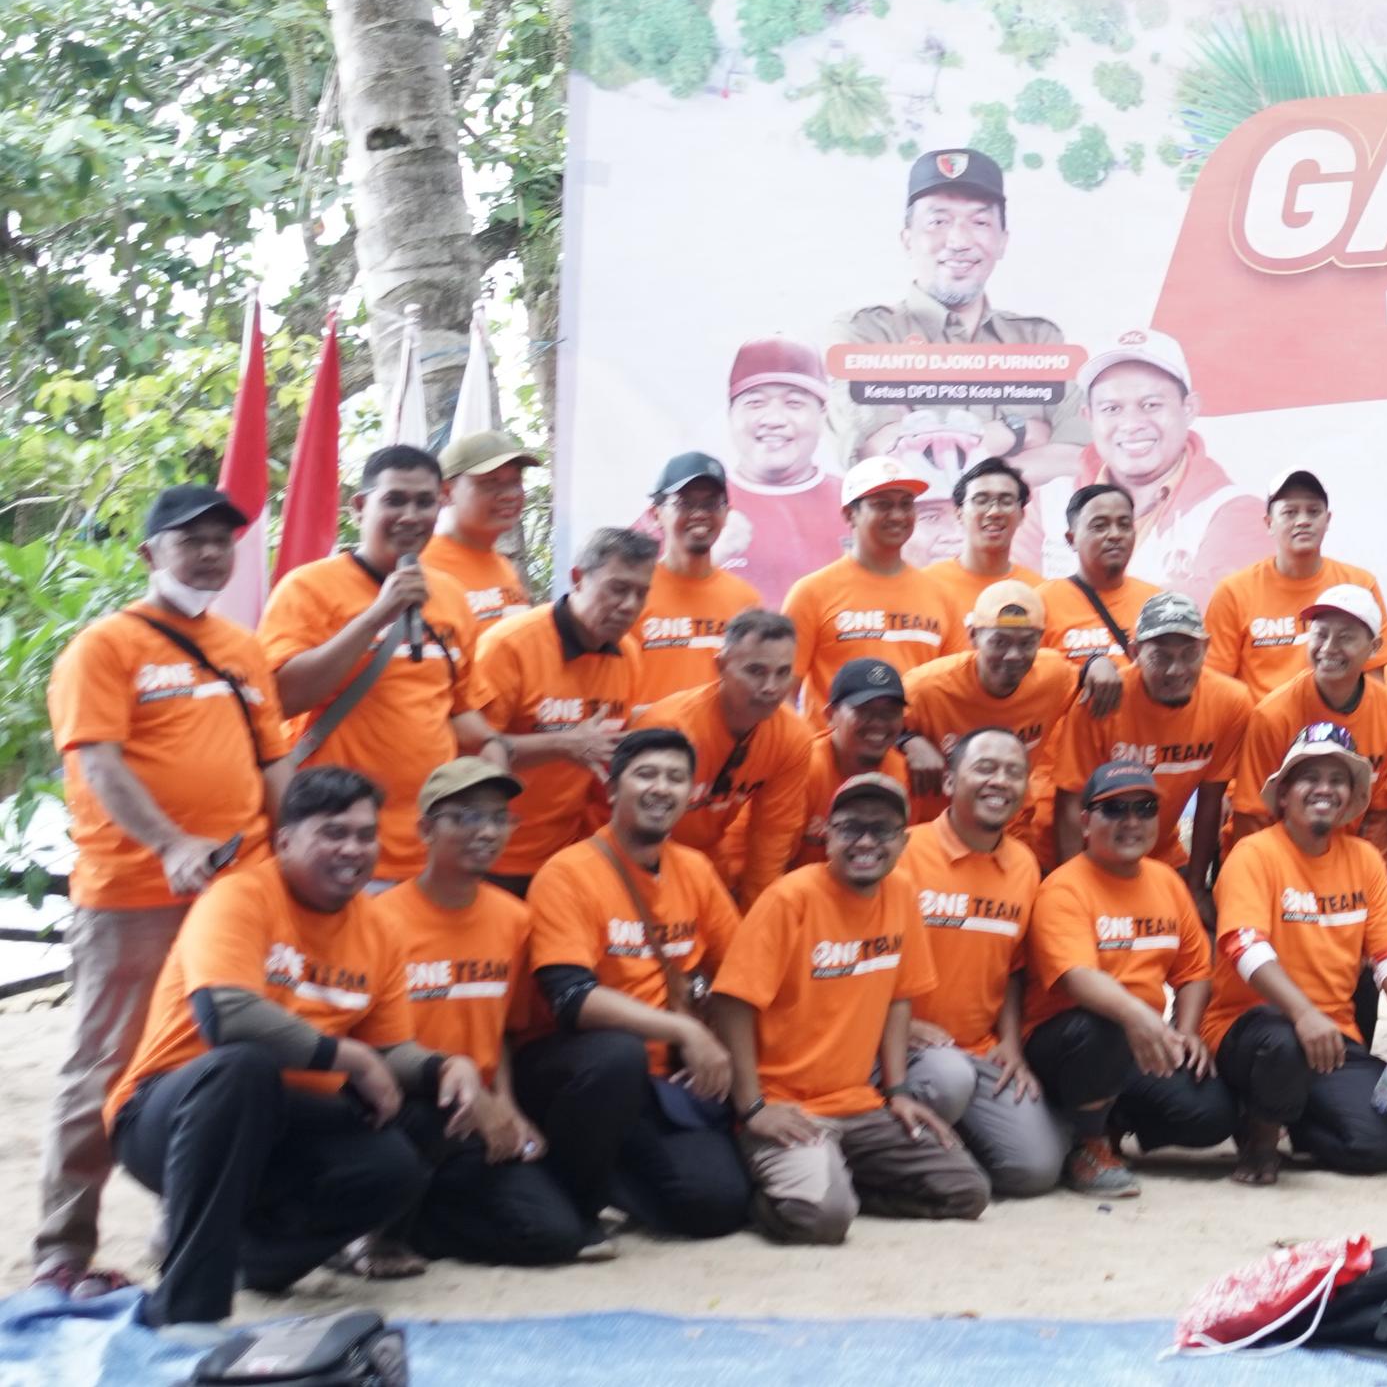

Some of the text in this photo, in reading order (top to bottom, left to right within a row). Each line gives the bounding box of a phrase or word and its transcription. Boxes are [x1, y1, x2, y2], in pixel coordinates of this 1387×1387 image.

[844, 353, 1070, 370] ERNANTO DJOKO PURNOMO
[864, 385, 1052, 401] Ketua DPD PKS Kota Malang
[641, 616, 727, 640] ONE TEA
[834, 609, 941, 633] ONE TEAM
[1250, 616, 1296, 639] ONE
[1110, 741, 1214, 764] ONE TEAM
[919, 889, 1023, 920] ONE TEAM
[1282, 886, 1367, 914] ONE TEAM
[1096, 915, 1178, 939] ONE TEAM
